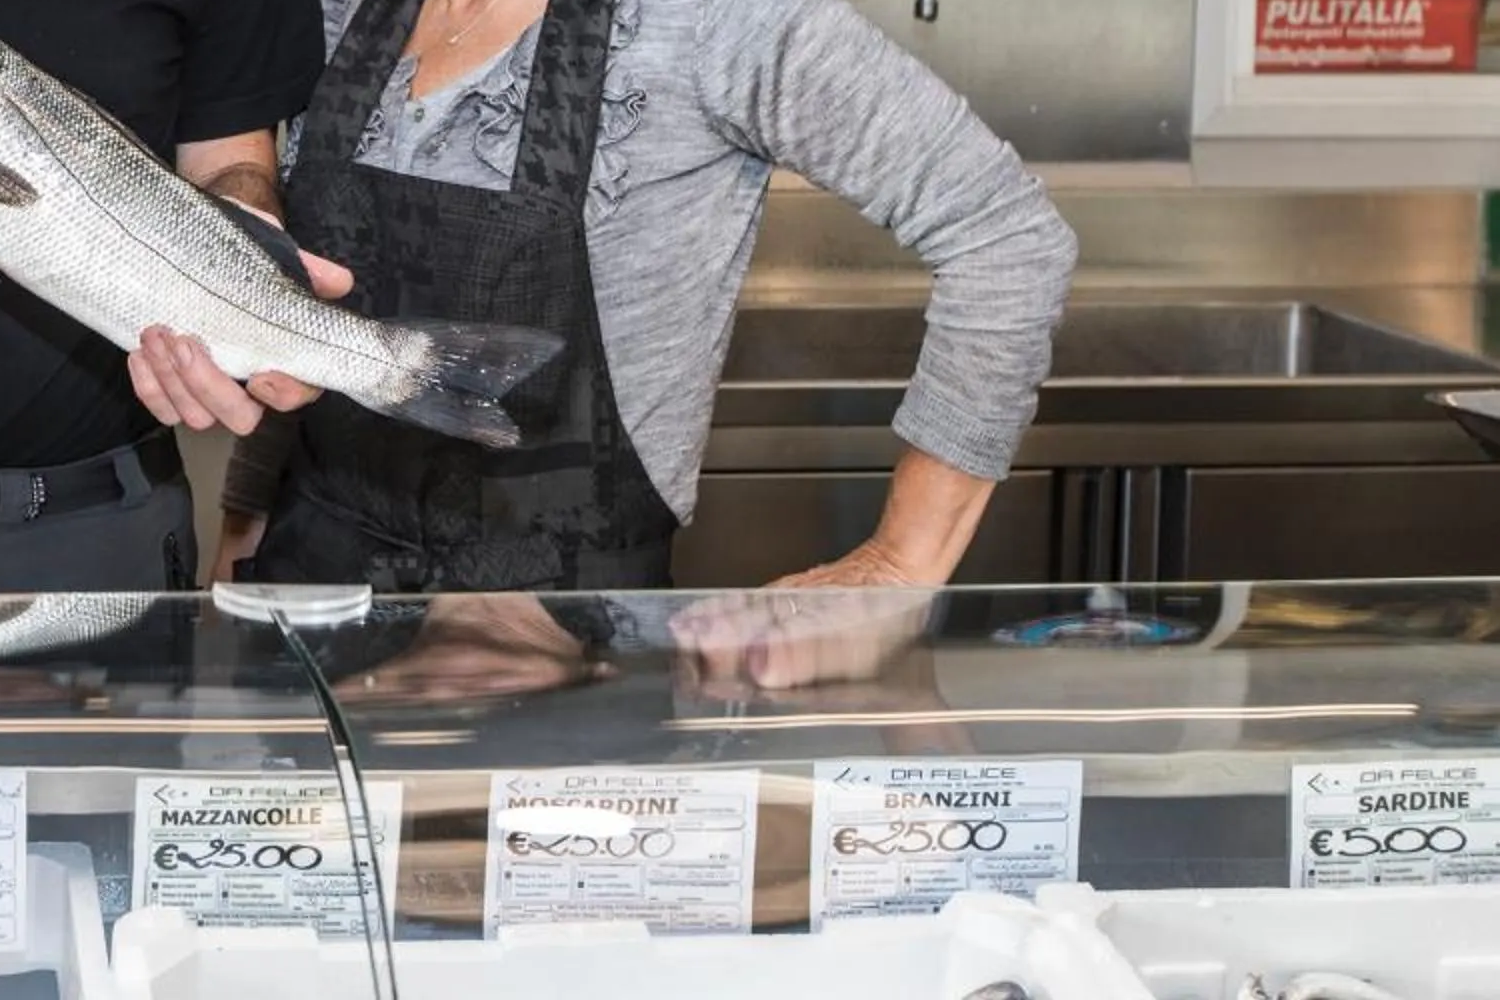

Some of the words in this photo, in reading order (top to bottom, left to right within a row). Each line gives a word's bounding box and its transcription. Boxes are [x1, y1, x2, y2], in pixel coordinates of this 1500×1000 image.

[931, 767, 1017, 779] FELICE
[885, 790, 1013, 809] BRANZINI
[1358, 791, 1470, 813] SARDINE
[160, 807, 323, 826] MAZZANCOLLE
